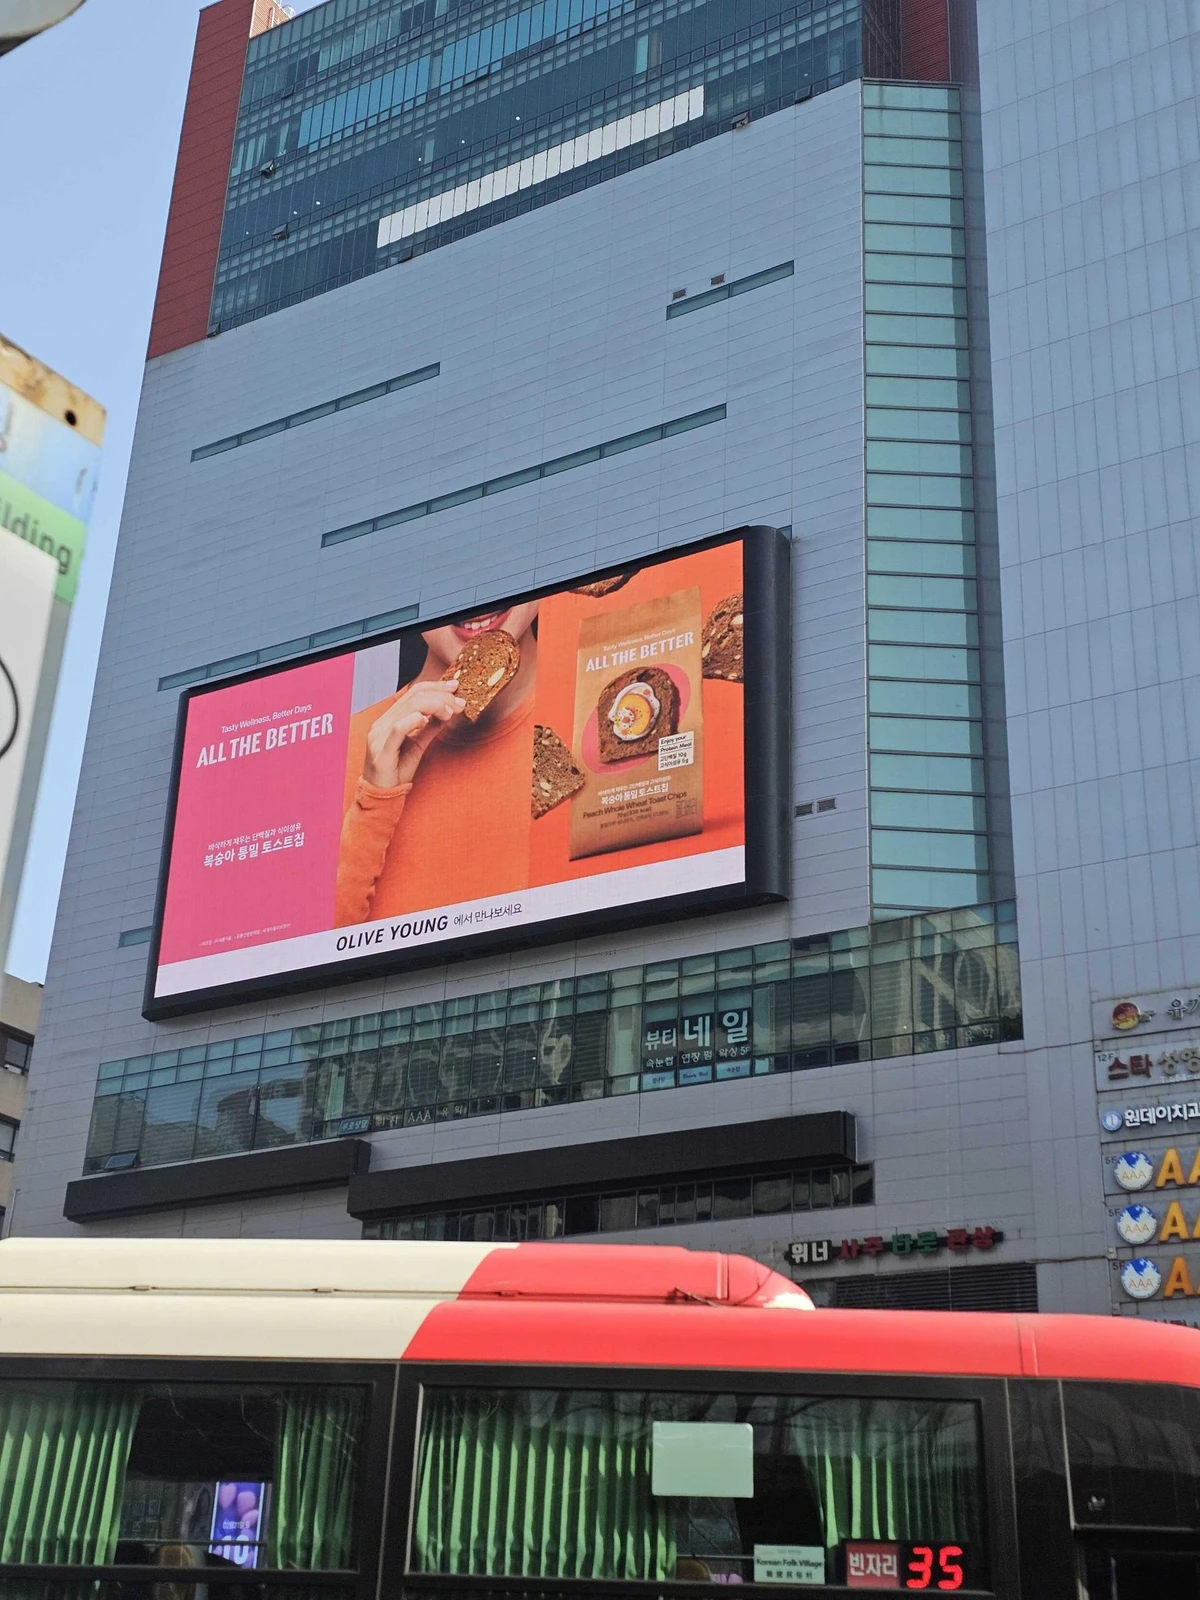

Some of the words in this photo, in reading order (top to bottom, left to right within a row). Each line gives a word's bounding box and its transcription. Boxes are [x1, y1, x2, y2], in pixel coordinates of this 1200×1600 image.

[585, 657, 609, 672] ALL
[611, 647, 637, 666] THE
[640, 631, 694, 659] BETTER
[221, 724, 239, 734] Tasty
[272, 708, 293, 720] Better
[294, 704, 312, 714] Days
[196, 742, 227, 768] ALL
[229, 732, 262, 759] THE
[265, 713, 334, 750] BETTER
[667, 791, 687, 801] Chips
[203, 848, 235, 868] 복숭아
[238, 842, 258, 860] 통밀
[261, 832, 305, 854] 토스트칩
[453, 911, 473, 926] 에서
[474, 903, 522, 922] 만나보세요
[336, 928, 384, 951] OLIVE
[390, 915, 449, 941] YOUNG
[645, 1027, 677, 1050] 뷰티
[646, 1055, 674, 1069] 속눈썹
[719, 1046, 738, 1058] 왁싱
[1108, 1054, 1153, 1080] 스타
[408, 1109, 431, 1123] AAA
[1105, 1155, 1117, 1165] 5F
[1122, 1170, 1147, 1180] AAA
[1108, 1208, 1120, 1217] 5F
[1125, 1223, 1150, 1234] AAA
[791, 1240, 829, 1264] 위너
[837, 1235, 884, 1260] 사주
[892, 1231, 938, 1256] 타로
[947, 1226, 995, 1252] 관상
[1129, 1279, 1154, 1289] AAA
[782, 1558, 798, 1567] Folk
[799, 1559, 823, 1569] Village
[849, 1553, 898, 1577] 빈자리
[906, 1546, 963, 1590] 35
